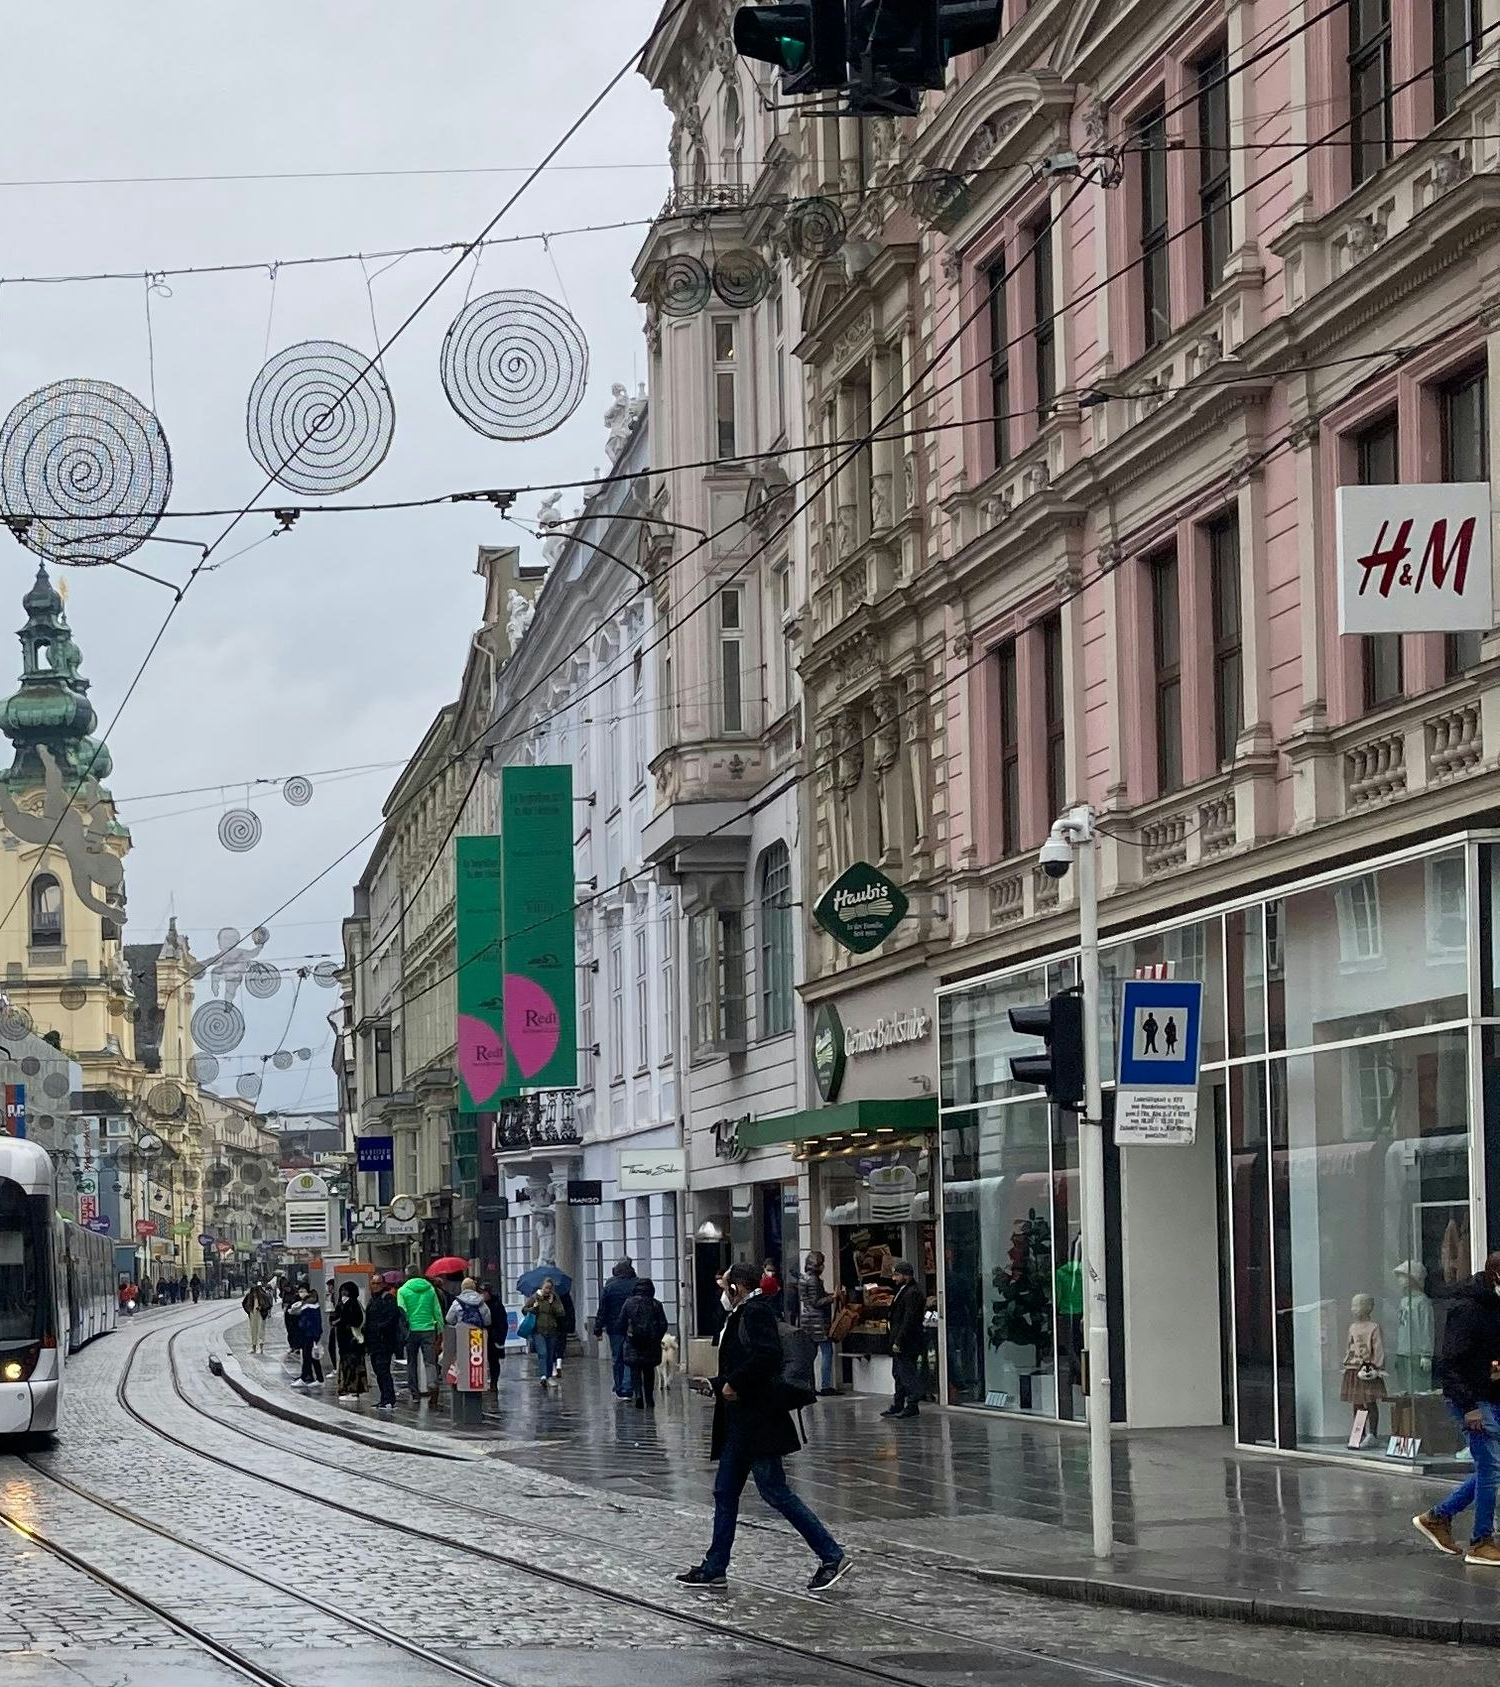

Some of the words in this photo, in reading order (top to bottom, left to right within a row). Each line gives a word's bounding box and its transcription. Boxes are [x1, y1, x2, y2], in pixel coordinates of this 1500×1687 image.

[1357, 516, 1476, 598] H&M
[833, 882, 889, 912] Haubis
[470, 1328, 484, 1366] oe24
